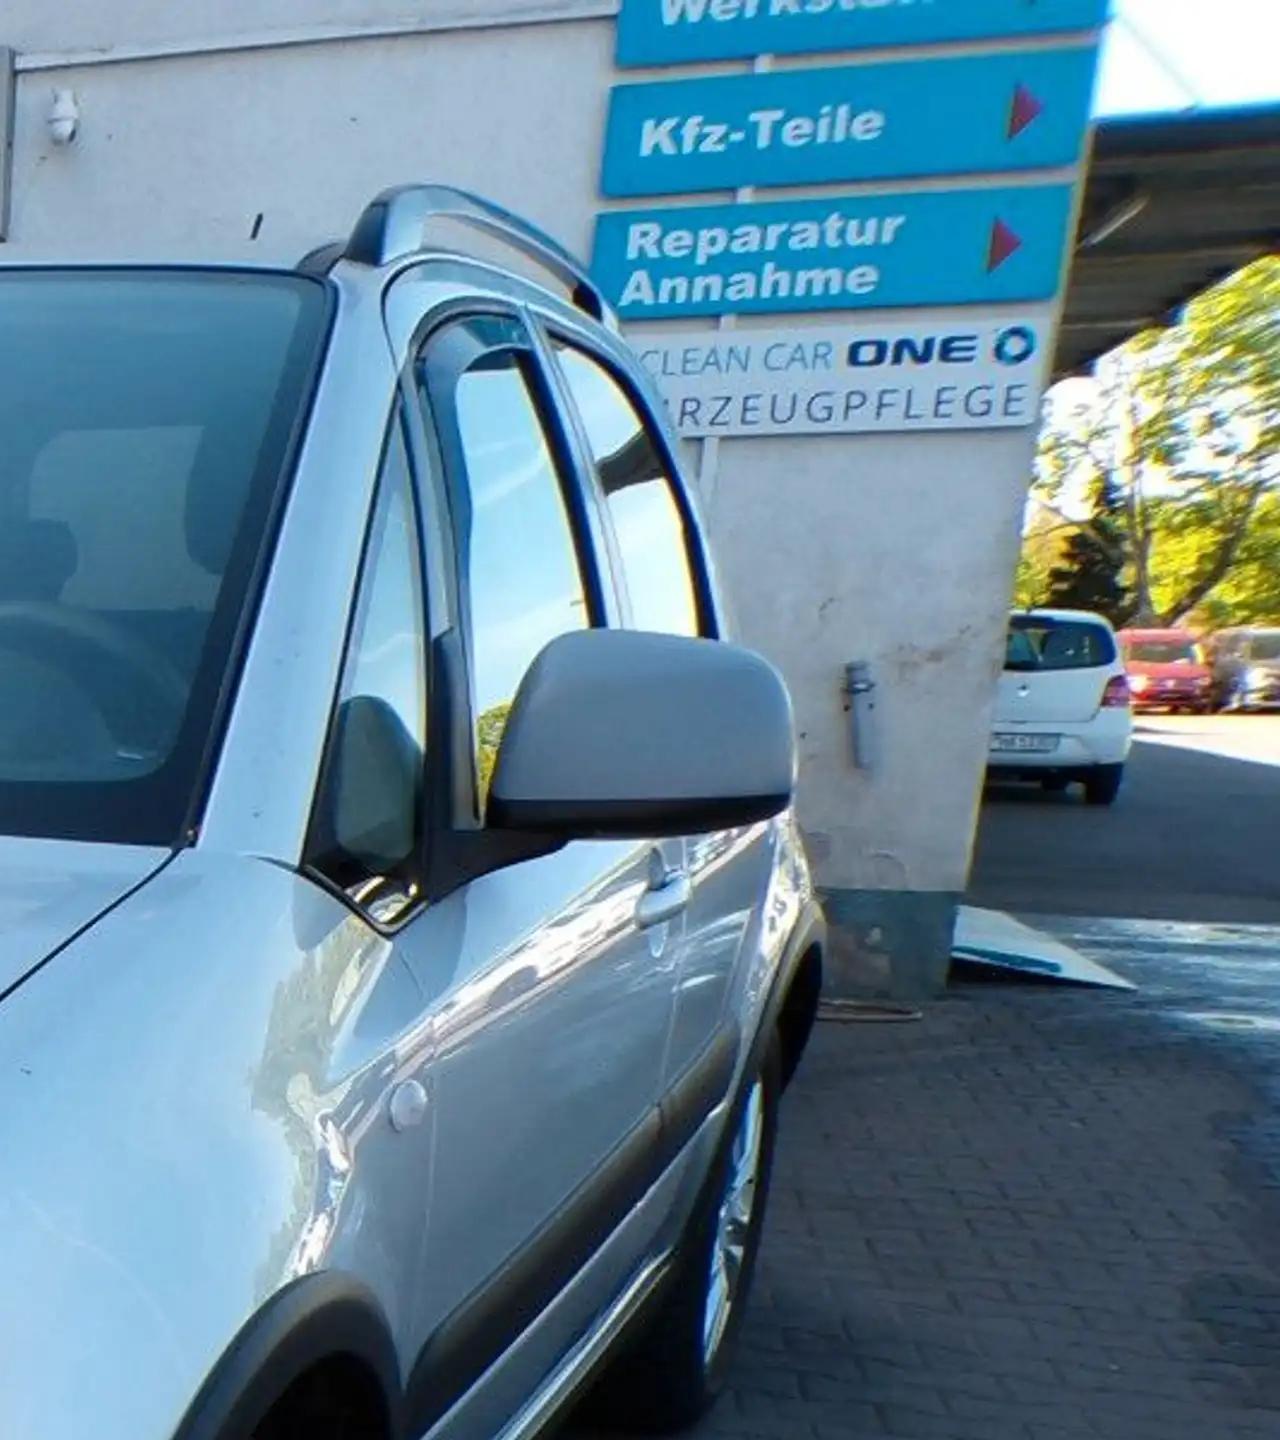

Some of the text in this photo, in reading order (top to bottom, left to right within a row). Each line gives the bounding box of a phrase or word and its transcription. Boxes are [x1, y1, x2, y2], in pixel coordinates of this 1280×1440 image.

[639, 103, 886, 157] Kfz-Teile
[626, 211, 907, 265] Reparatur
[618, 261, 880, 306] Annahme
[639, 334, 979, 376] CLEAN CAR ONE
[664, 383, 1028, 428] RZEUGPFLEGE
